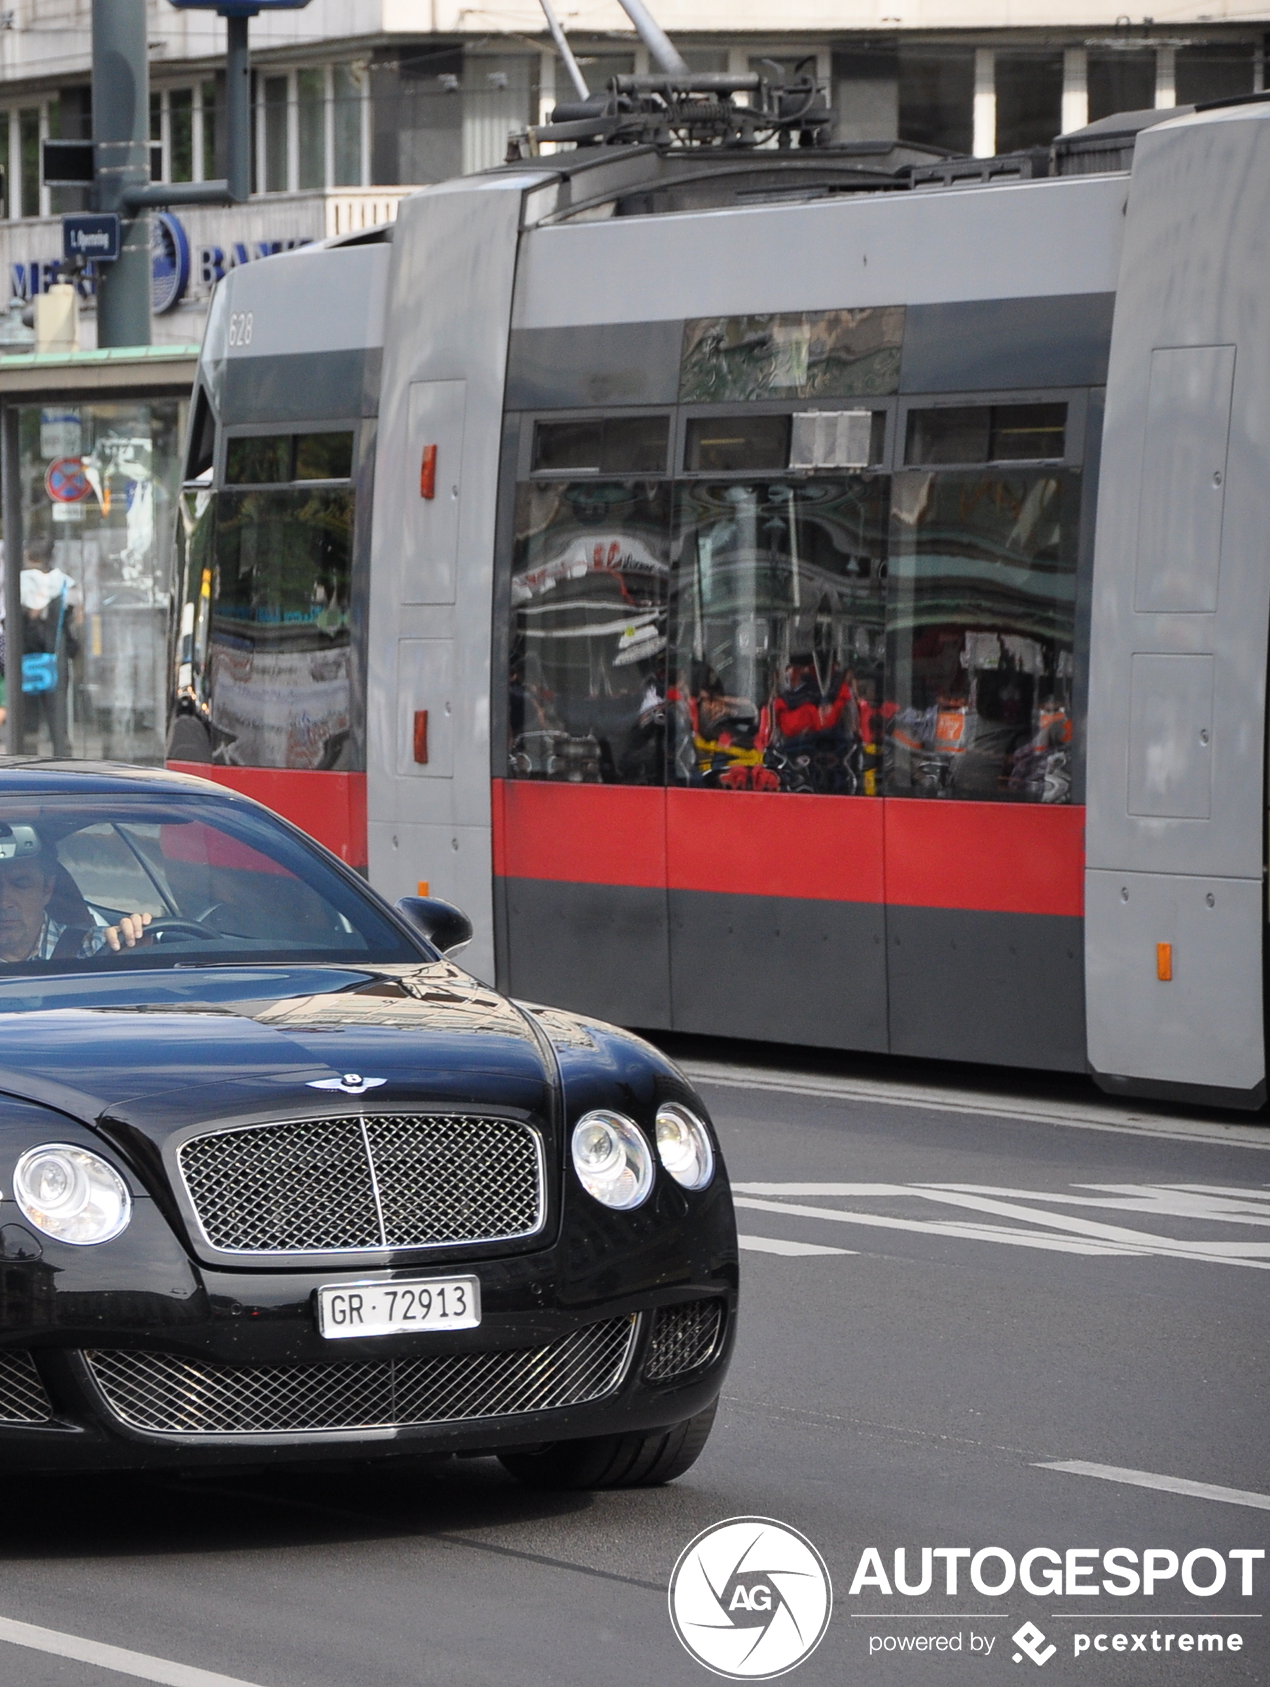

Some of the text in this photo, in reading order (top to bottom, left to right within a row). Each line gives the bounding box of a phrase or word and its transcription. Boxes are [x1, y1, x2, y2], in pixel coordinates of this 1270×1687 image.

[229, 312, 253, 346] 628
[331, 1286, 467, 1325] GR 72913
